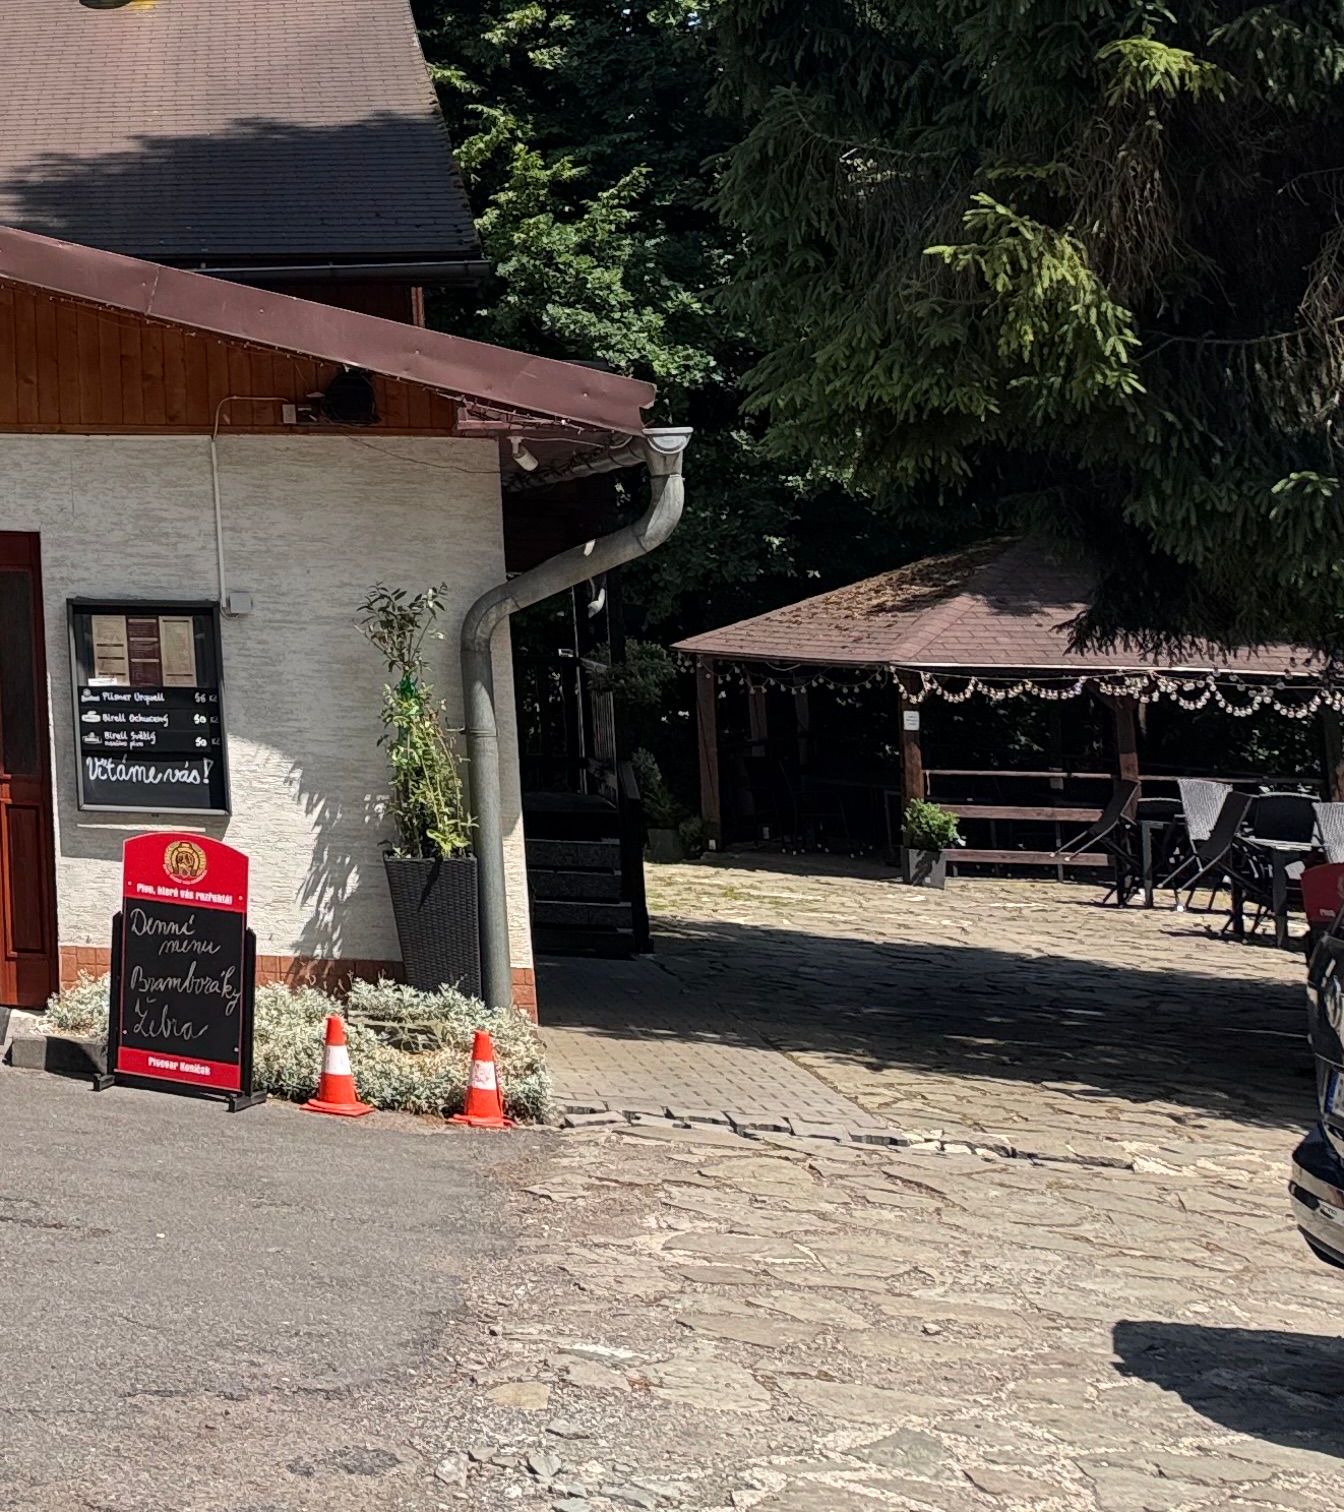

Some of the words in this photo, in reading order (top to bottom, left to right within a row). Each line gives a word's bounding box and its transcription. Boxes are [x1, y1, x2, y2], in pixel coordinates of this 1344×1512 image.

[102, 691, 132, 701] Pilsner
[102, 712, 127, 723] Birell
[193, 713, 207, 724] 50
[104, 730, 128, 740] Birell
[194, 736, 208, 748] 50
[85, 753, 163, 784] Vítáme
